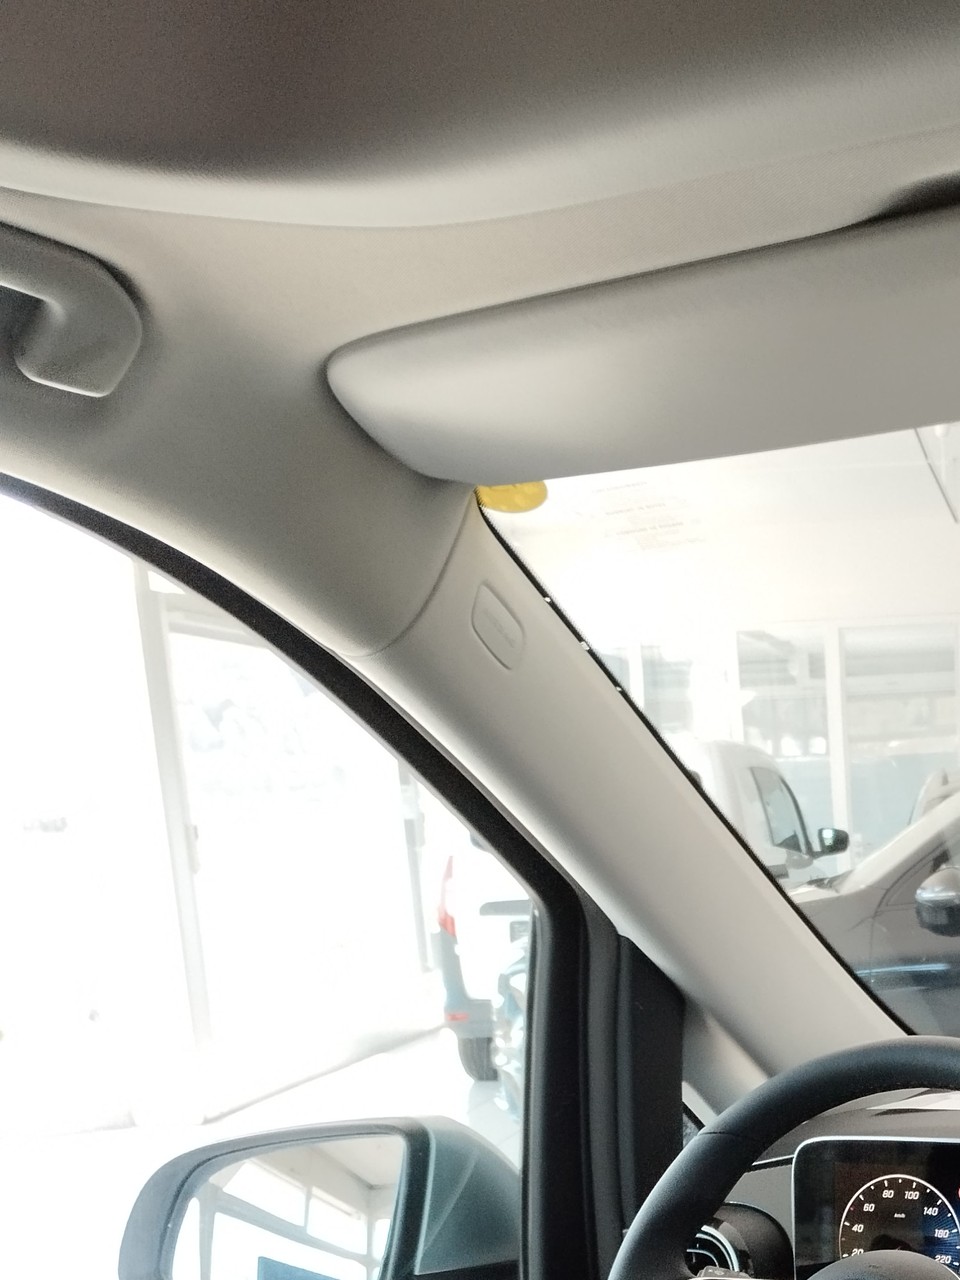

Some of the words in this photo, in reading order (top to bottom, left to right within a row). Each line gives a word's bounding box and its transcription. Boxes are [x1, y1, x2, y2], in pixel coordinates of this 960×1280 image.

[882, 1190, 894, 1199] 80
[904, 1191, 920, 1200] 100
[863, 1203, 875, 1212] 60
[923, 1207, 939, 1216] 140
[852, 1224, 864, 1233] 40
[934, 1229, 950, 1238] 180
